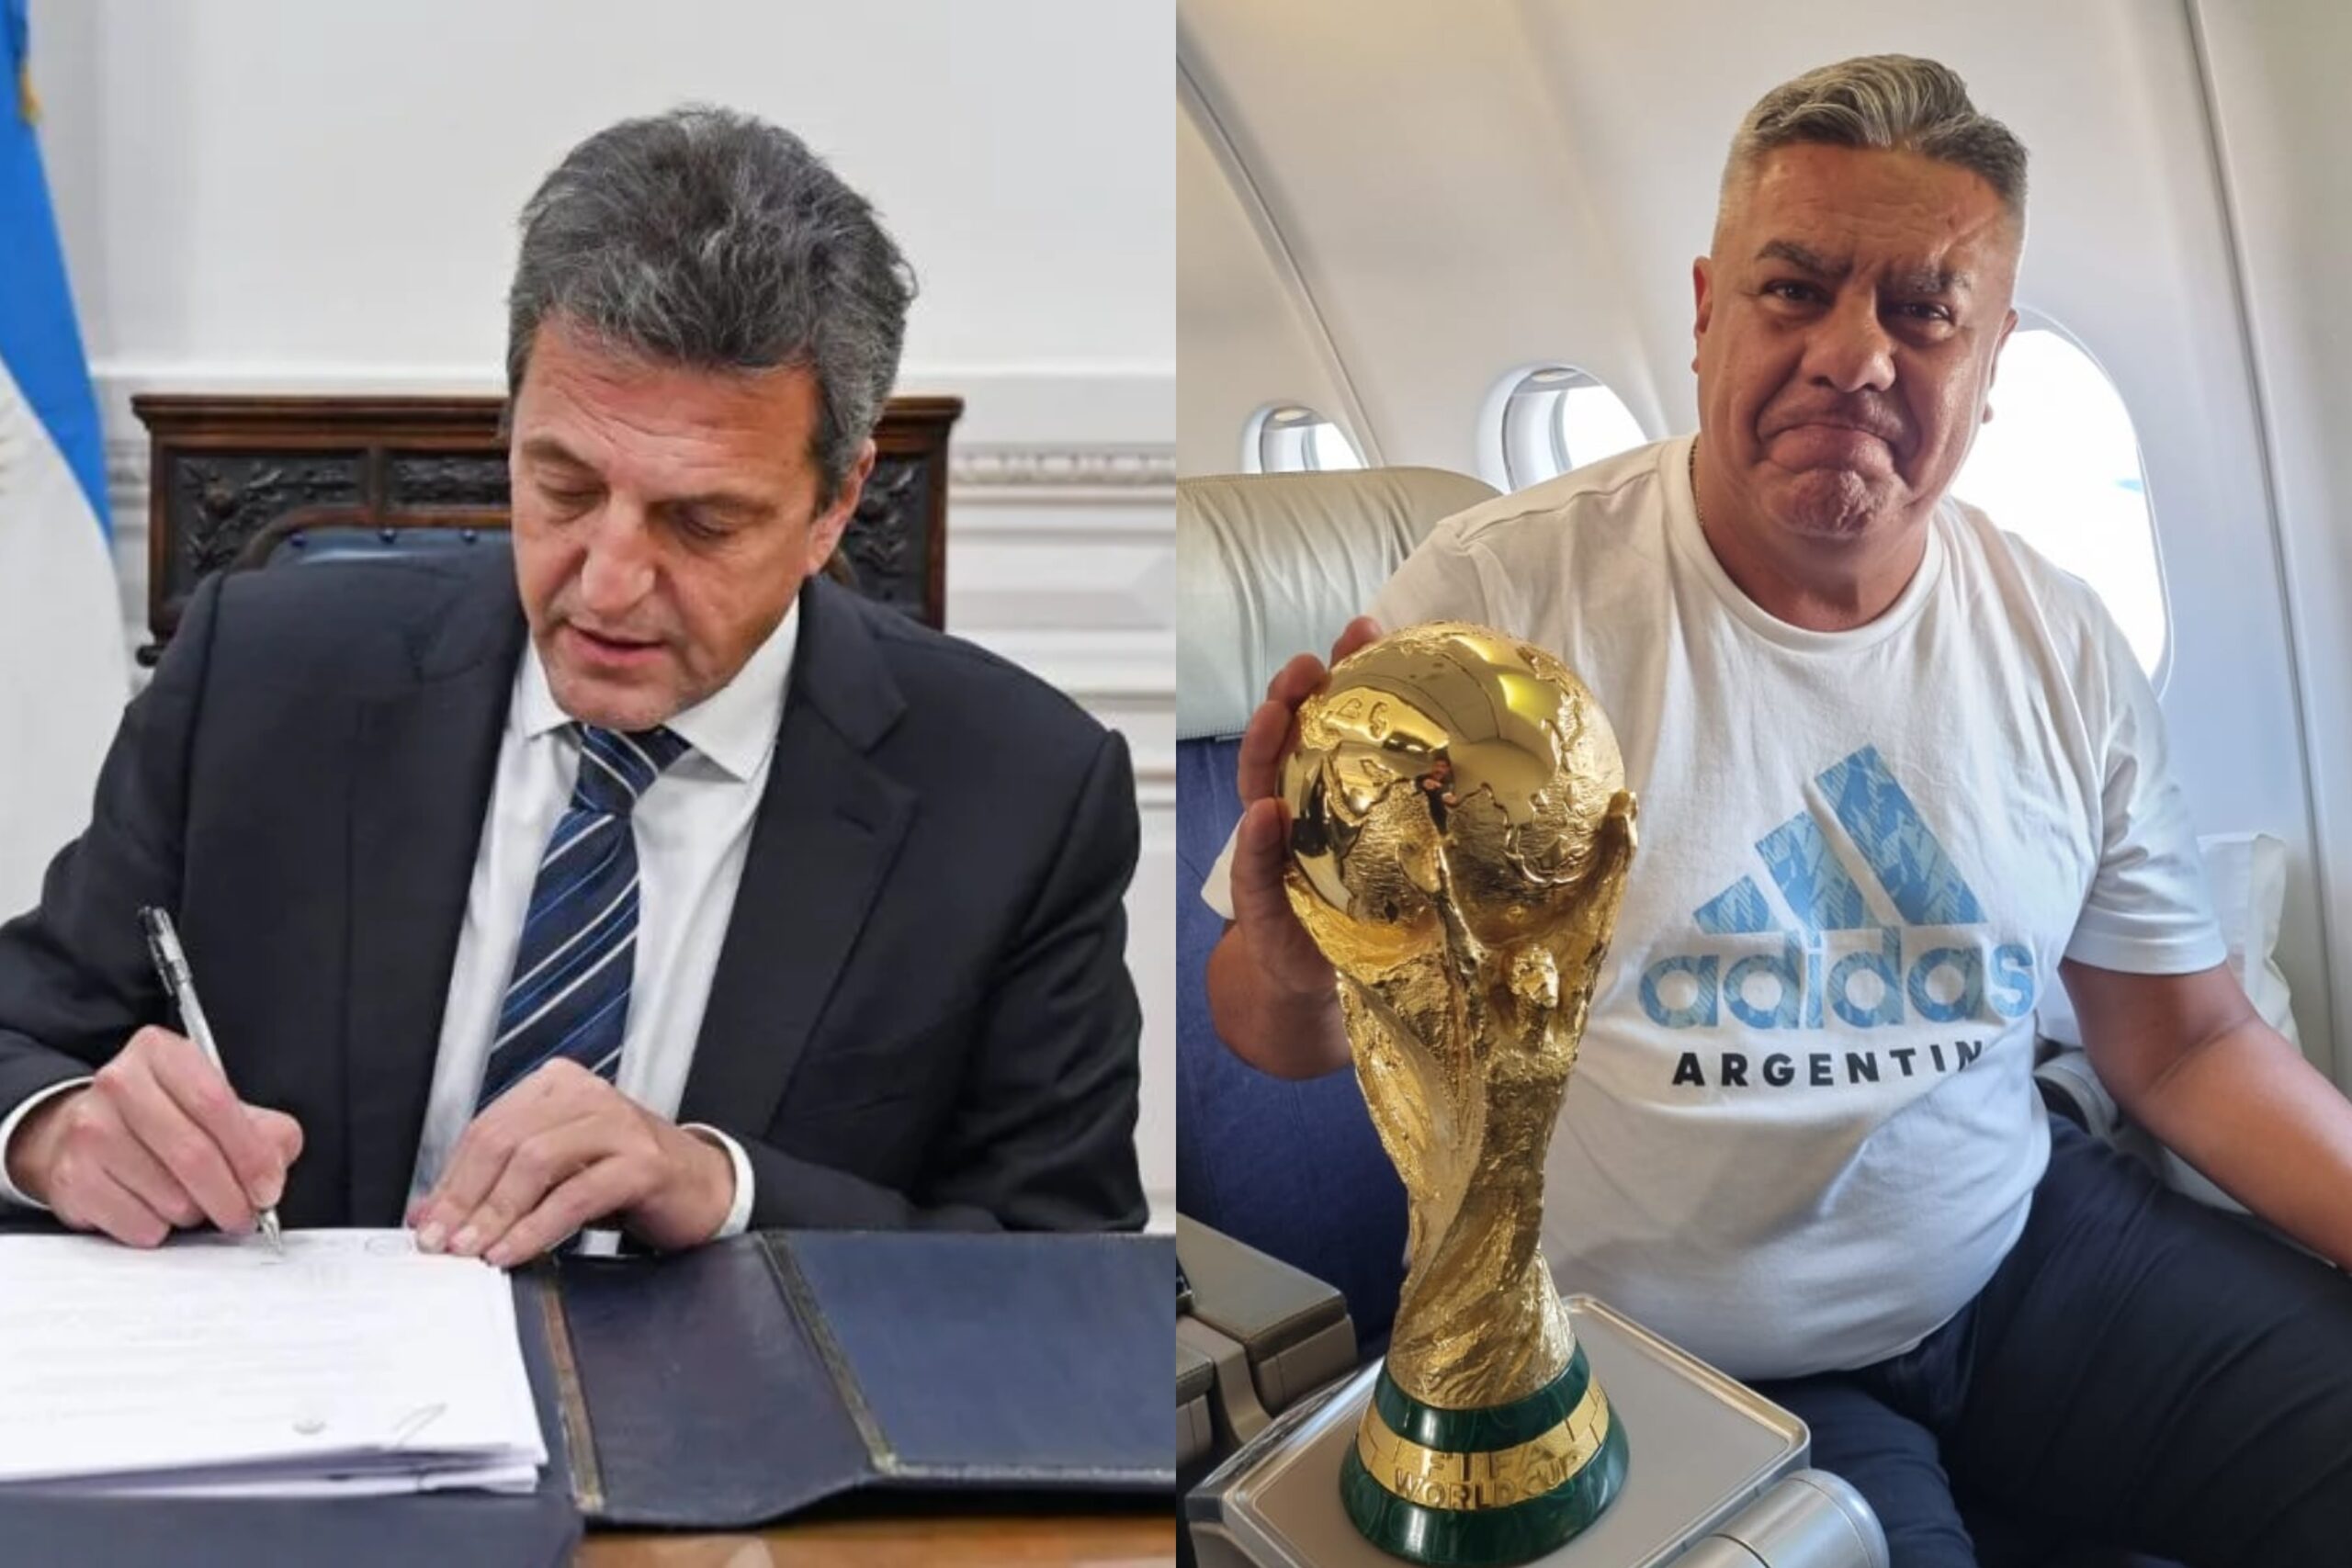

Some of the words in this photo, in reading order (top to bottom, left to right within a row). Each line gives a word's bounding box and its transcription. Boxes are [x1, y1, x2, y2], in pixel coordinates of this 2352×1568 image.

[1638, 926, 2035, 1030] adidas
[1671, 1040, 1983, 1087] ARGENTIN
[1429, 1443, 1555, 1481] FIFA
[1394, 1467, 1518, 1509] WORLD
